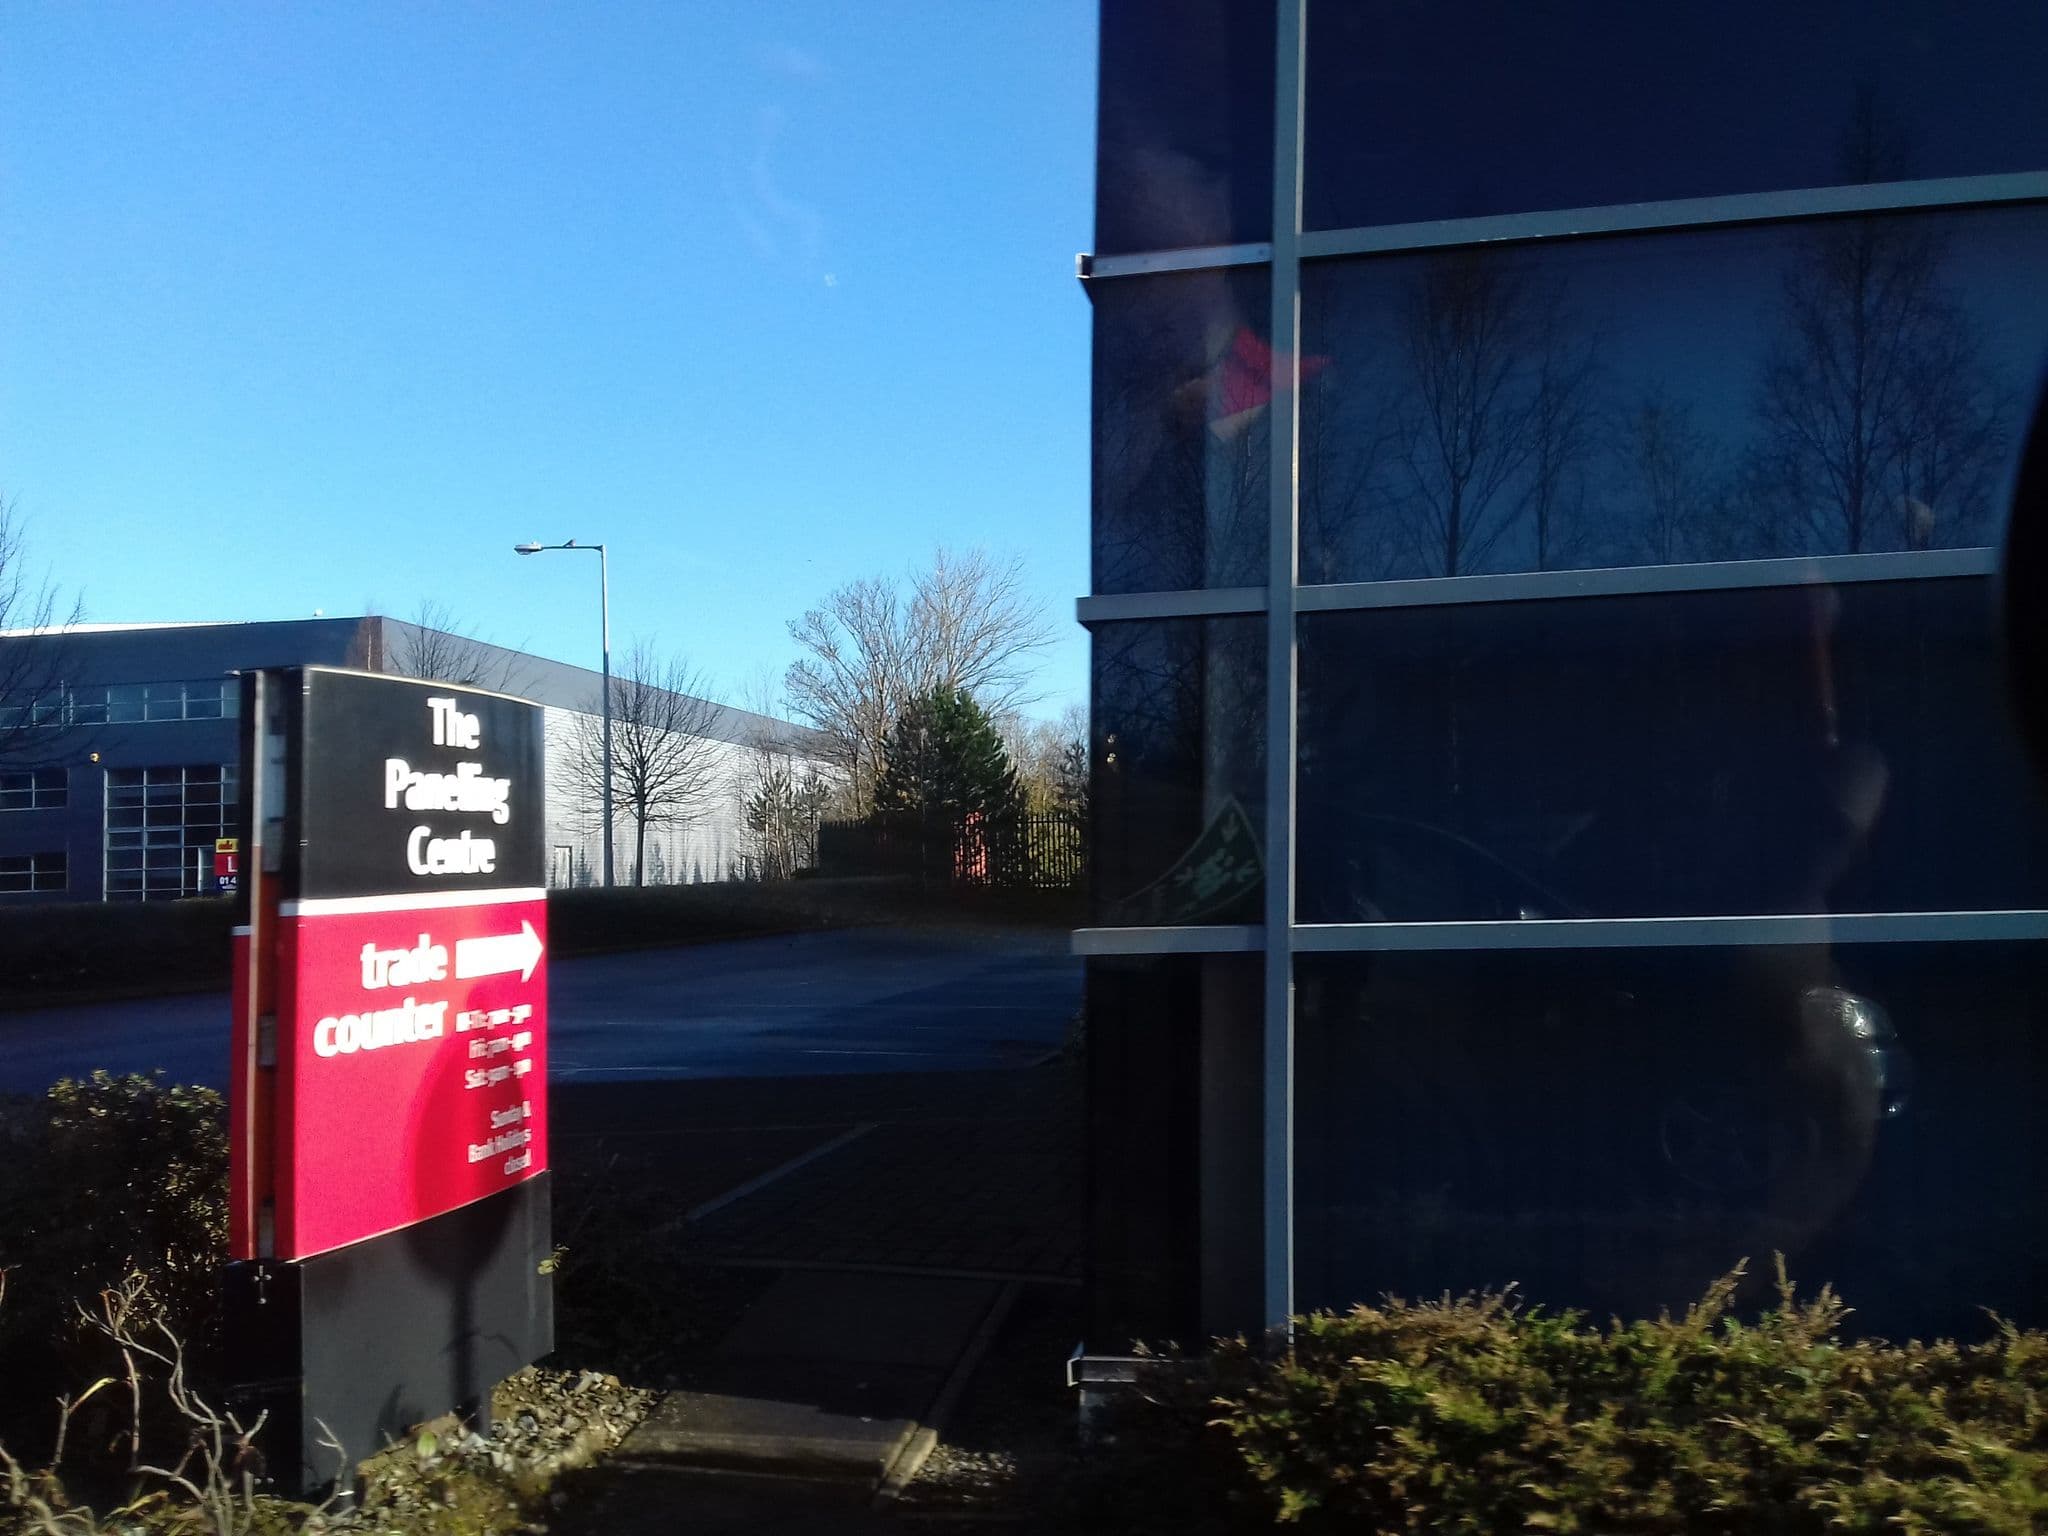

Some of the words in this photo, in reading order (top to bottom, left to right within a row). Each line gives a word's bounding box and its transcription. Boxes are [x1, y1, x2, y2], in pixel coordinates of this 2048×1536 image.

[427, 697, 480, 750] The
[407, 825, 496, 876] Centre
[360, 933, 449, 990] trade
[313, 997, 448, 1057] counter
